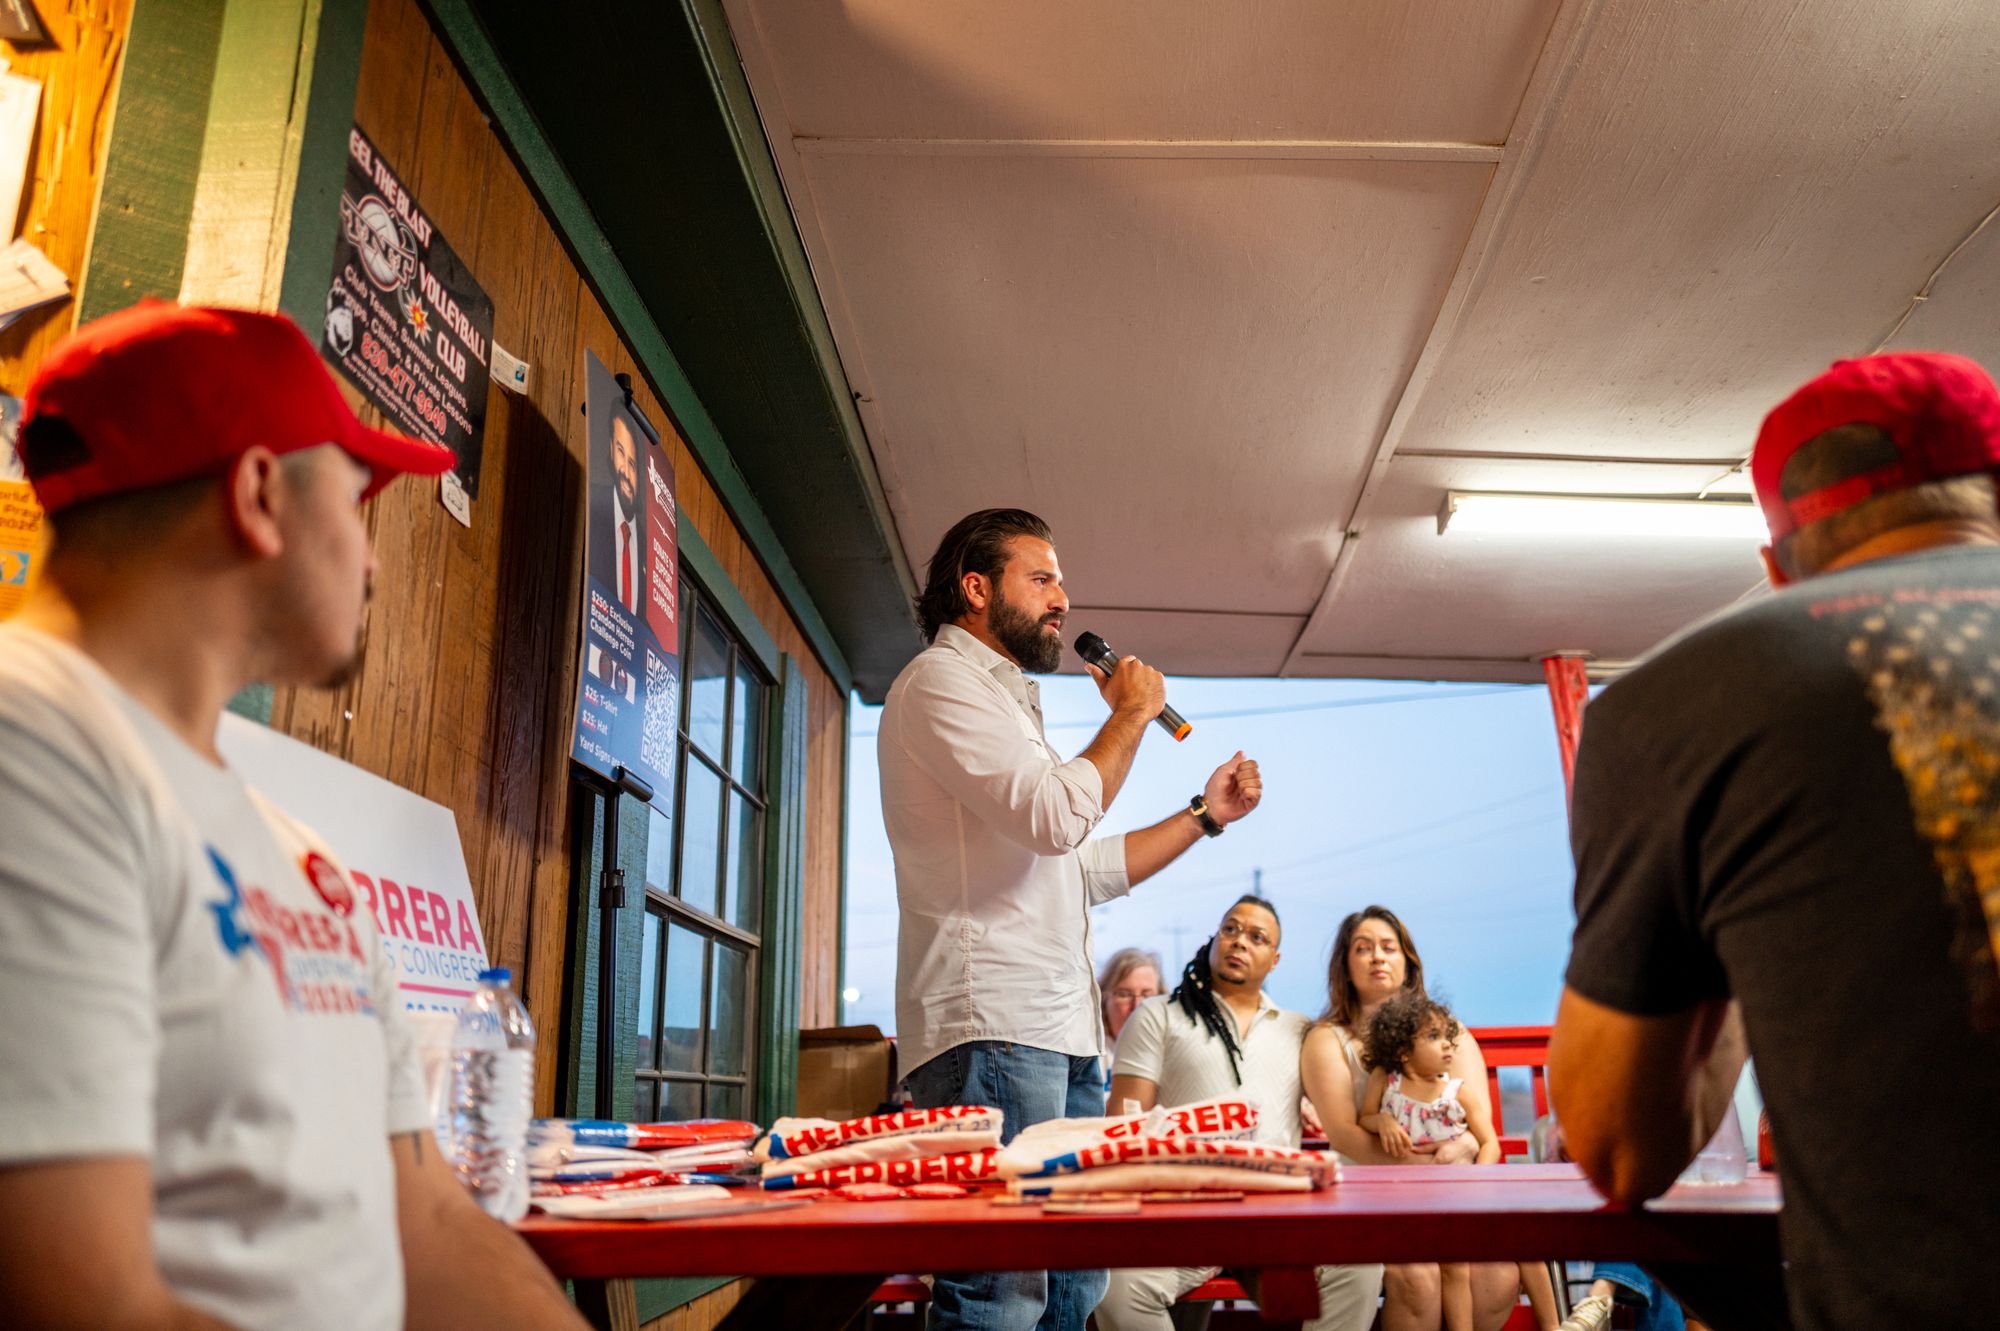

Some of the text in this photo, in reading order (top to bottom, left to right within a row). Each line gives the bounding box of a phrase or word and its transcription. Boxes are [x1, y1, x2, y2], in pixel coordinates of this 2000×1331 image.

[374, 157, 397, 206] THE
[396, 187, 432, 250] BLAST
[419, 260, 487, 367] VOLLEYBALL
[333, 276, 369, 328] Cmps,
[371, 317, 402, 364] Clinics,
[413, 363, 440, 401] Private
[441, 394, 472, 435] Lessons
[344, 264, 468, 413] Club Teams, Summer Leagues,
[436, 331, 466, 383] CLUB
[590, 604, 635, 651] Brandon Herrera
[590, 618, 632, 661] Challenge Coin
[609, 605, 634, 636] Exclusive
[597, 720, 608, 735] Hat
[600, 694, 618, 716] T-shirt
[579, 734, 595, 753] Yard
[594, 744, 611, 765] Signs
[402, 944, 486, 983] CONGRESS
